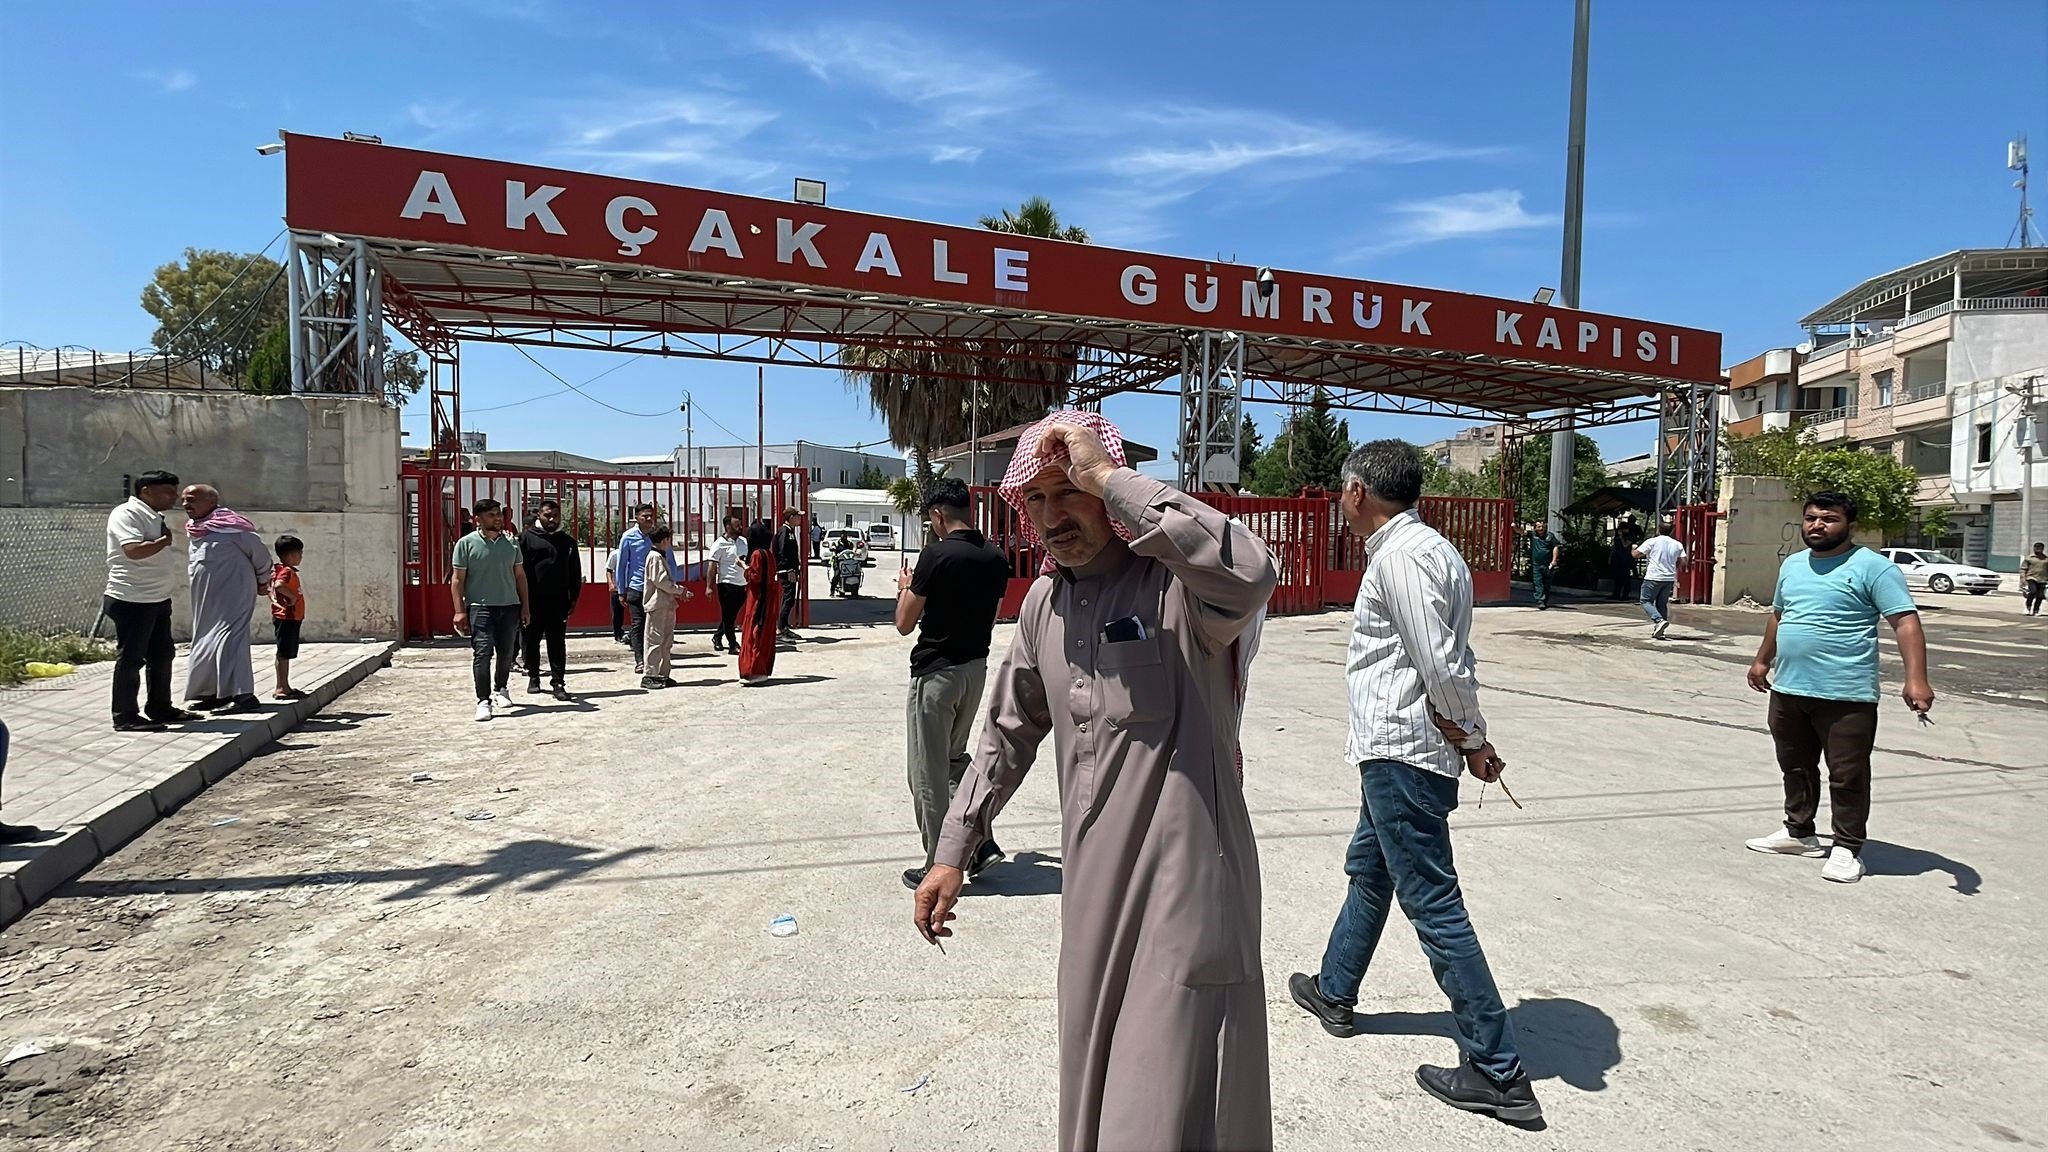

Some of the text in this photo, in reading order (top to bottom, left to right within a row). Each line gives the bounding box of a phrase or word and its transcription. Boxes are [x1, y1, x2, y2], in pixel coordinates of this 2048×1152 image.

[400, 171, 1679, 365] AKÇAKALE GÜMRÜK KAPISI
[1207, 470, 1234, 481] DUR
